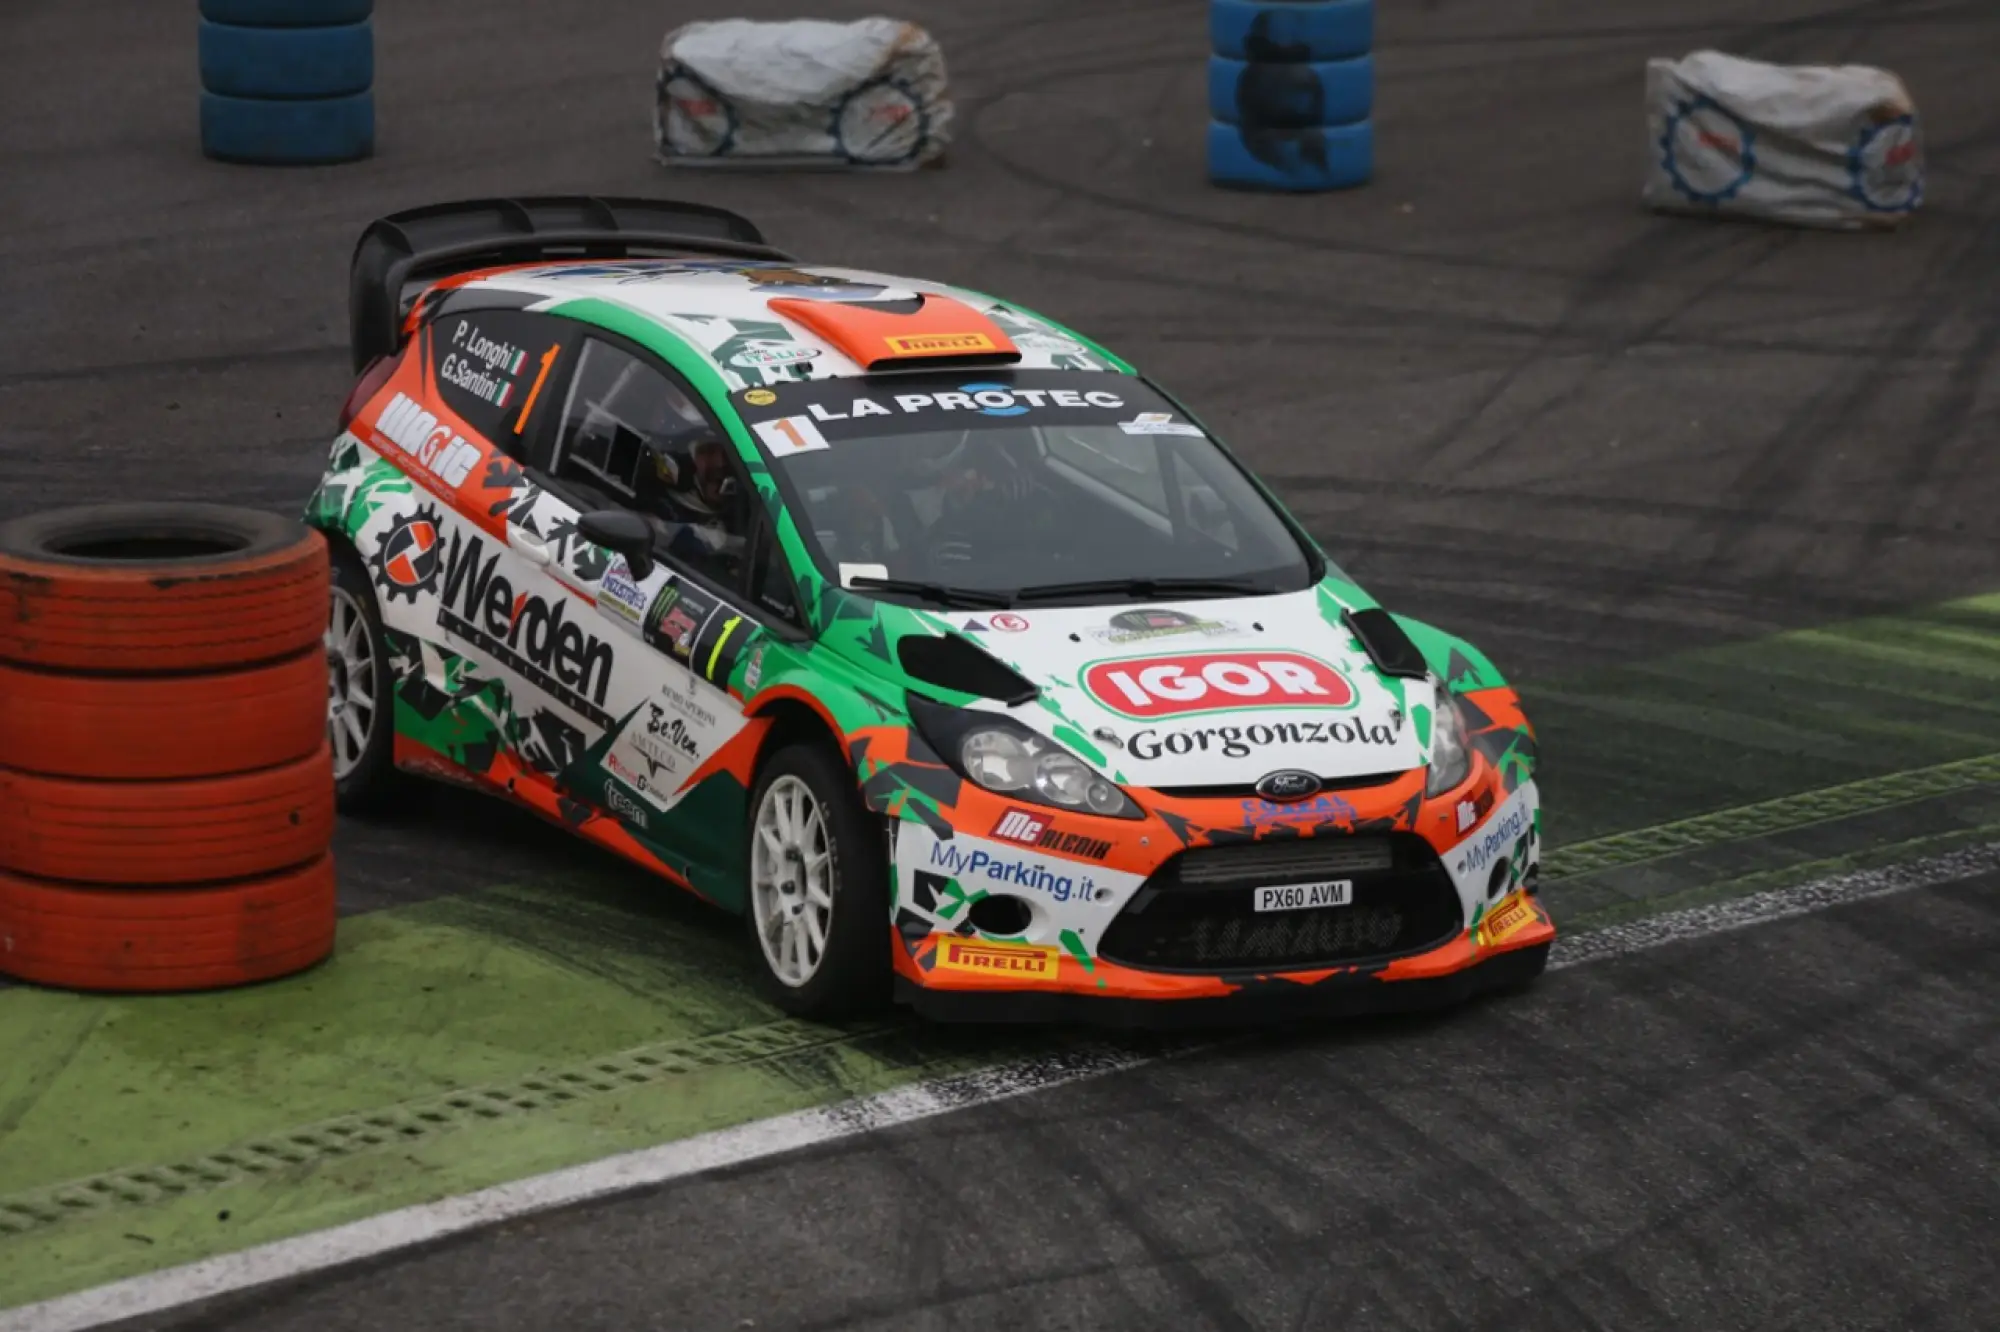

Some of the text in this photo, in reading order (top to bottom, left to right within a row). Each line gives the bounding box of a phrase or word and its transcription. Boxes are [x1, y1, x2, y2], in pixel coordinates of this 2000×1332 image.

[452, 319, 516, 370] P. Longhi
[898, 335, 983, 350] PIRELLI
[441, 353, 501, 402] G.Santini
[513, 343, 561, 435] 1
[807, 389, 1124, 421] LA PROTEC
[773, 418, 807, 447] 1
[441, 525, 613, 707] Werden
[706, 615, 743, 681] 1
[1106, 661, 1329, 707] IGOR
[1128, 716, 1398, 760] Gorgonzola
[1273, 775, 1307, 794] Ford
[1466, 803, 1528, 872] MyParking.it
[930, 842, 1094, 901] MyParking.it
[1263, 883, 1344, 909] PX60 AVM
[1488, 899, 1528, 938] PIRELLI
[948, 944, 1048, 972] PIRELLI
